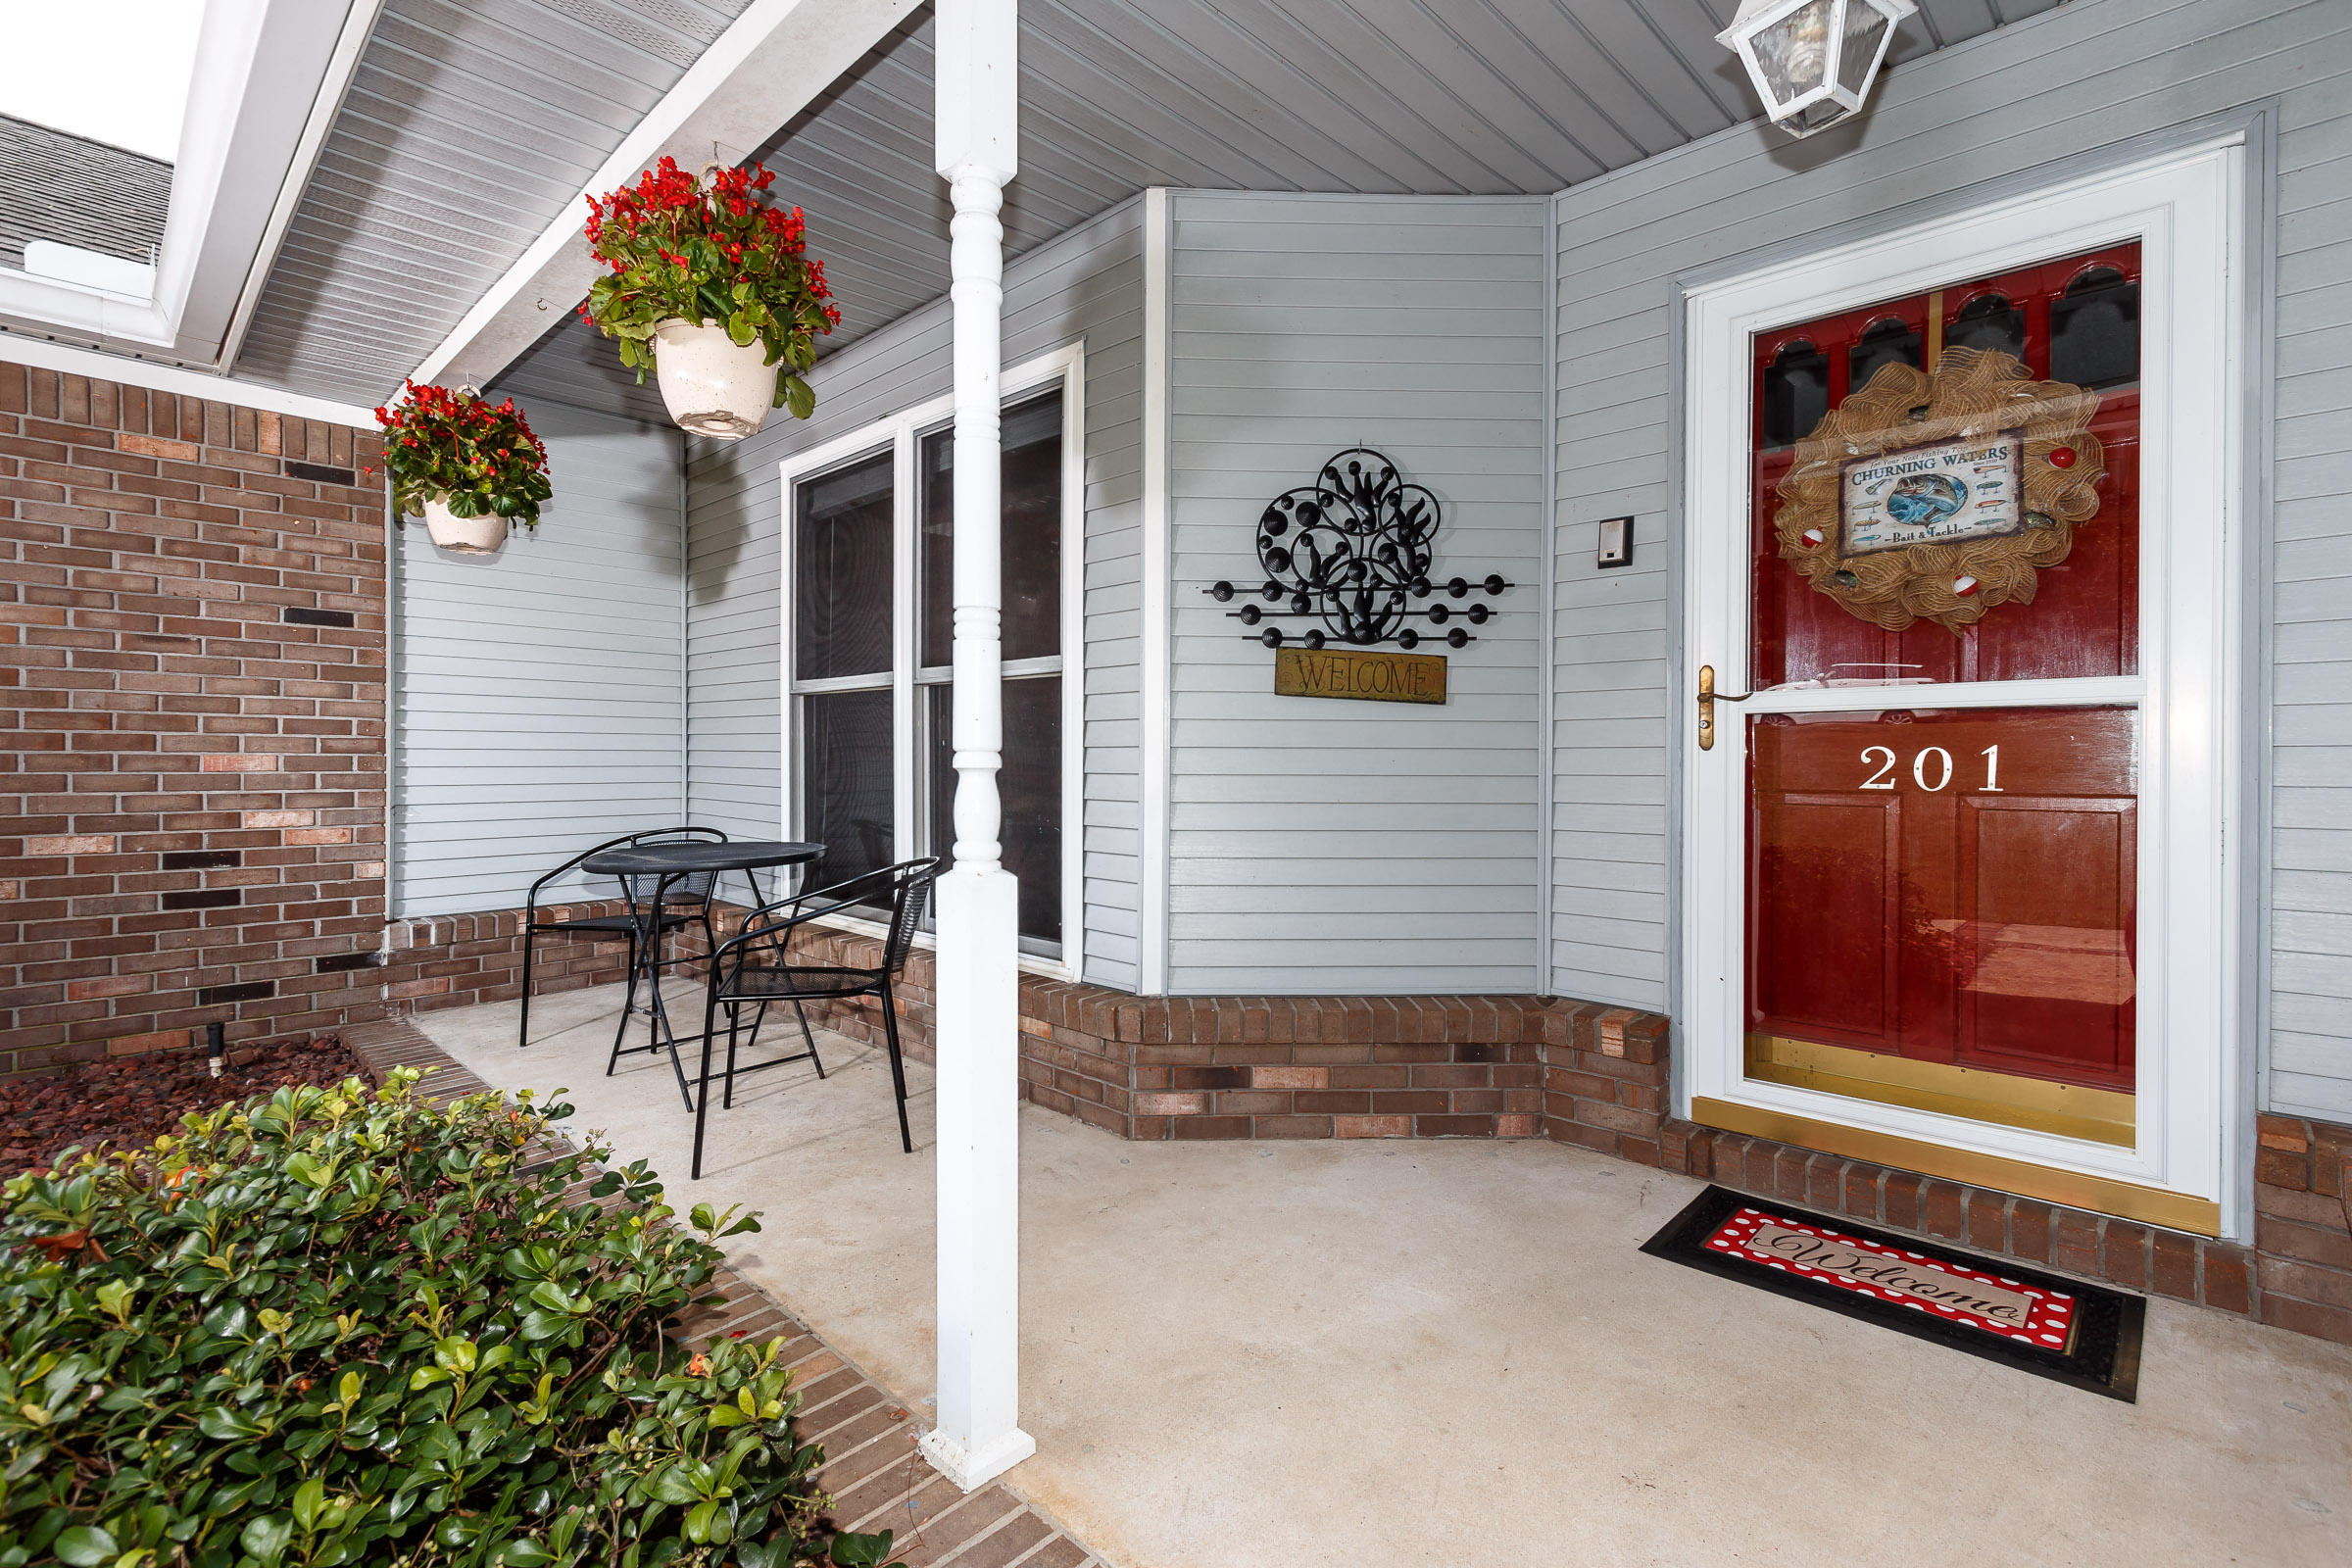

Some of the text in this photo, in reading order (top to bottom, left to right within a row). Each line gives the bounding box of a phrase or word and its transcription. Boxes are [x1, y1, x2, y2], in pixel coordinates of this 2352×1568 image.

[1852, 458, 1936, 486] CHURNING
[1902, 454, 1919, 463] Next
[1921, 449, 1949, 459] Fishing
[1295, 655, 1430, 696] WELCOME
[1858, 744, 2004, 792] 201
[1753, 1233, 2026, 1324] Welcome
